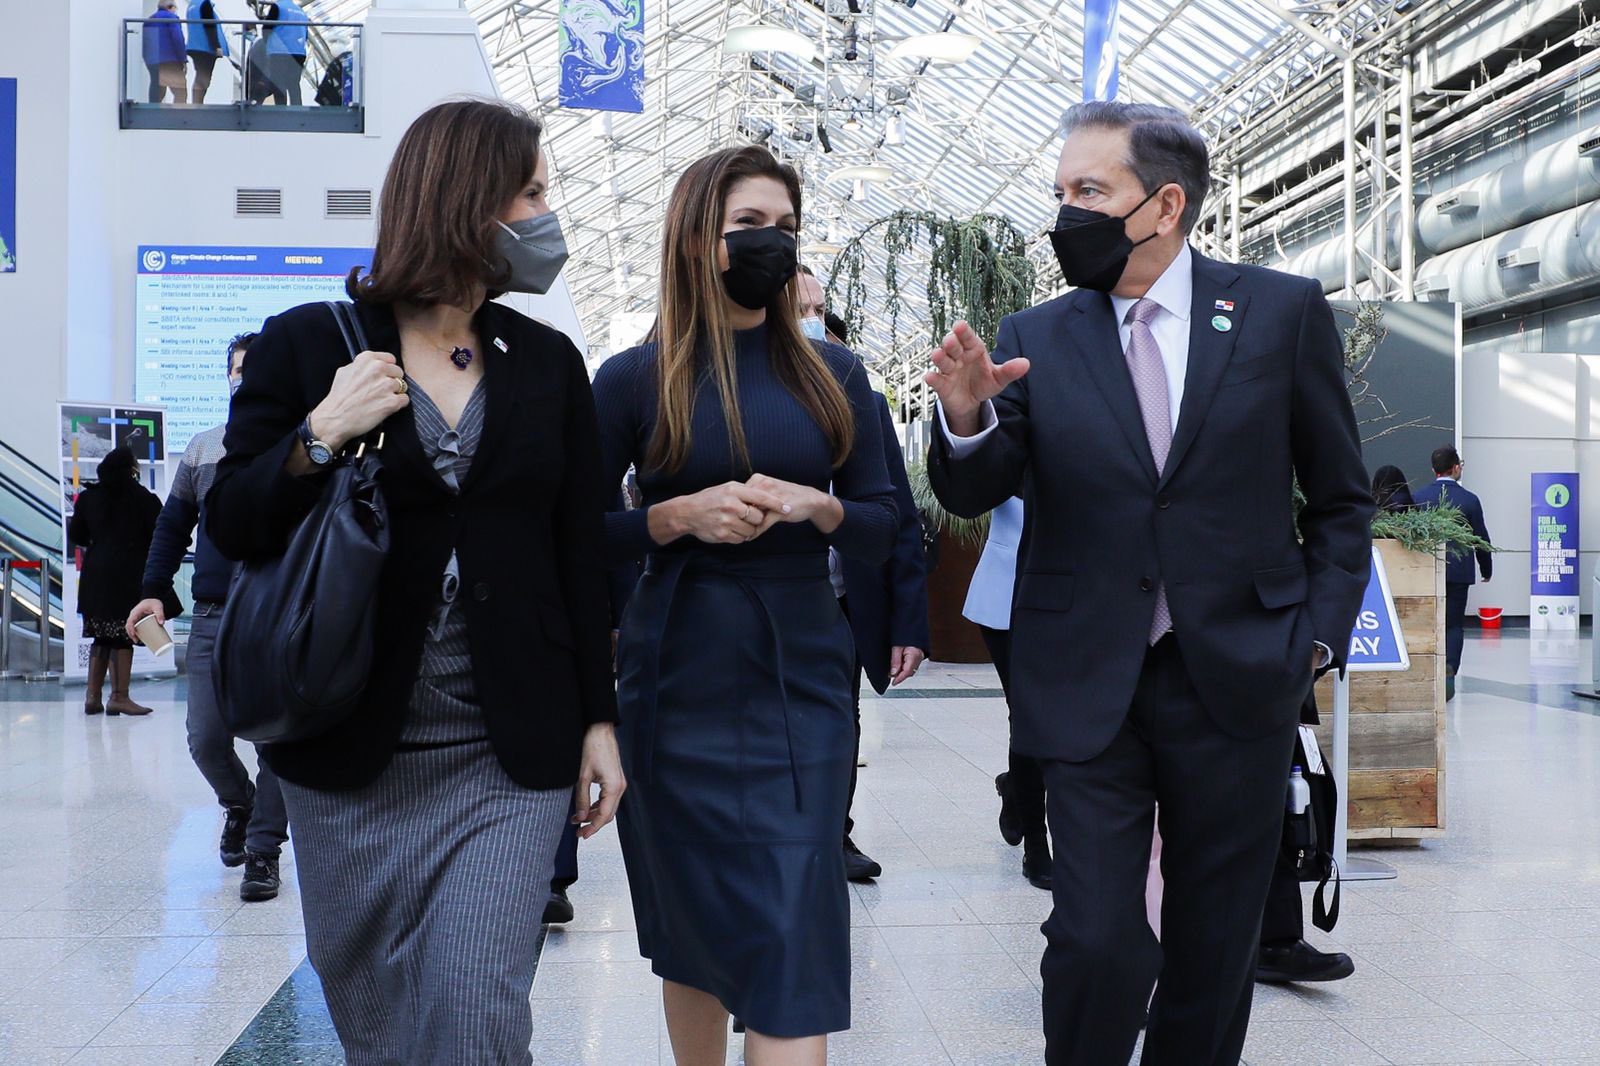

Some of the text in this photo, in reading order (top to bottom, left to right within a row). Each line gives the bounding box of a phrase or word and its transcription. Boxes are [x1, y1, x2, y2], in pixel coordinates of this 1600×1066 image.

[205, 254, 222, 262] Change
[285, 255, 323, 264] MEETINGS
[1538, 541, 1562, 549] WE ARE
[1538, 549, 1577, 558] DISINFECTING
[1538, 557, 1566, 566] SURFACE
[1538, 565, 1574, 574] AREAS WITH
[1538, 574, 1561, 583] DETTOL
